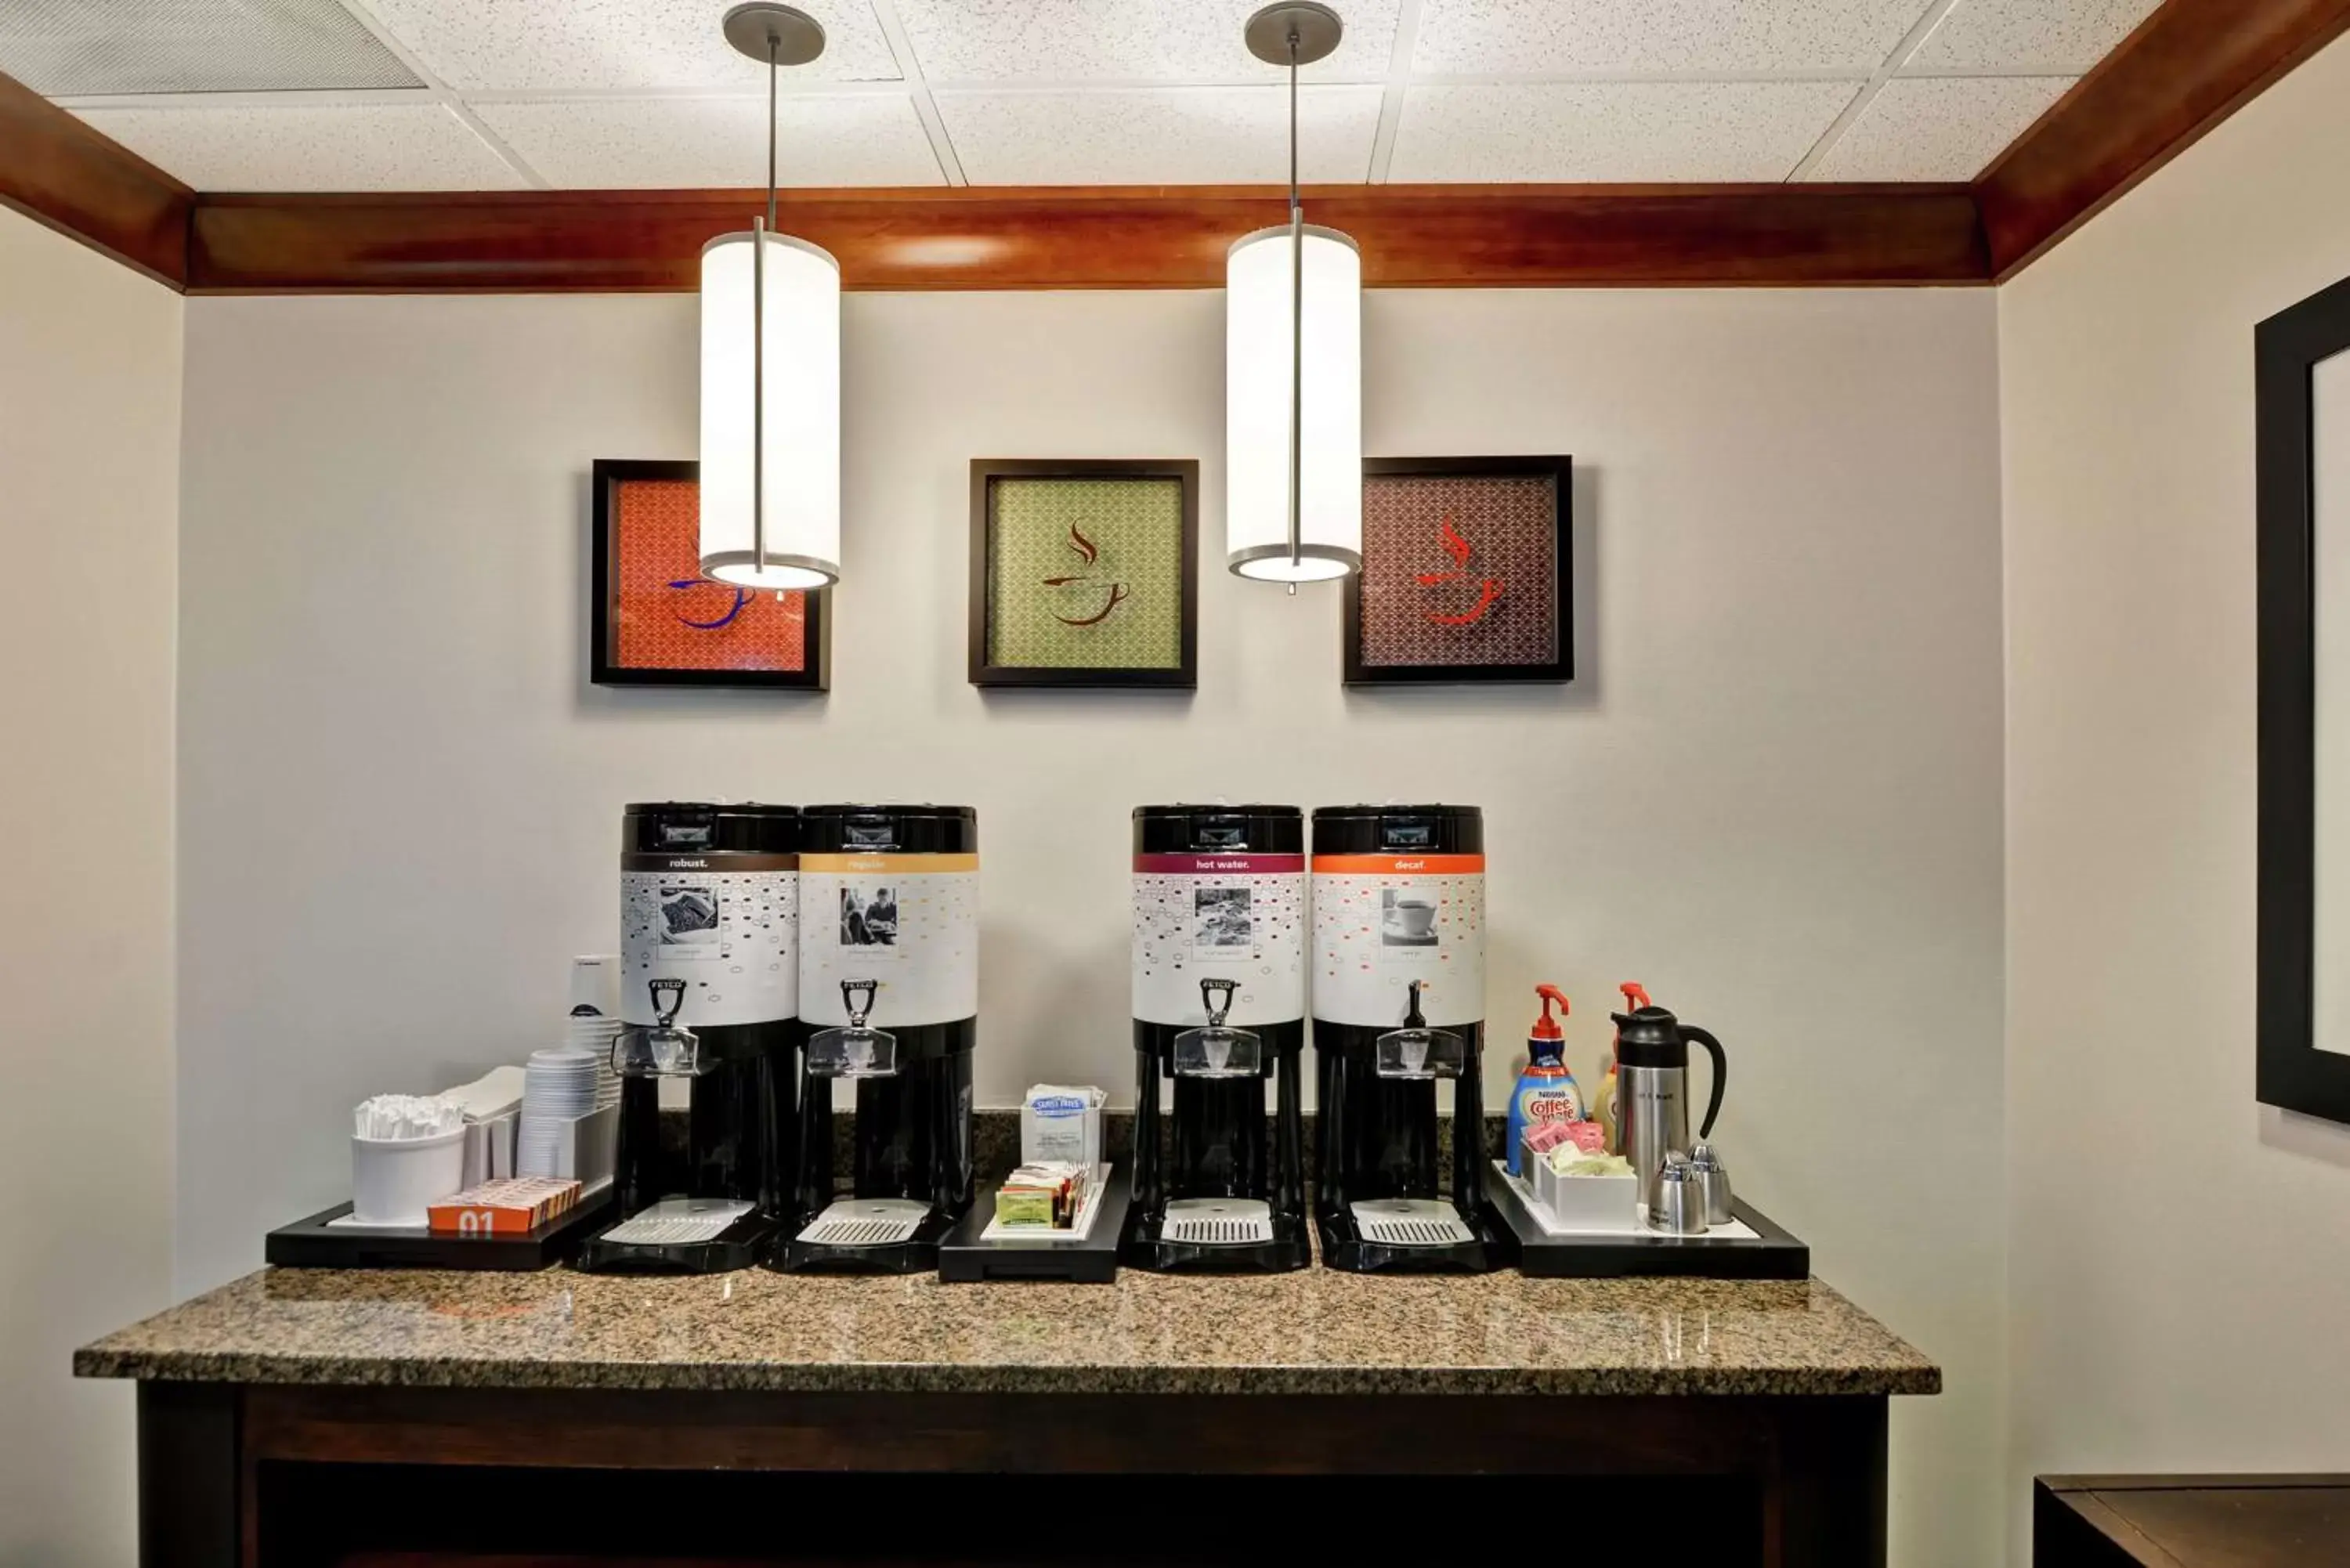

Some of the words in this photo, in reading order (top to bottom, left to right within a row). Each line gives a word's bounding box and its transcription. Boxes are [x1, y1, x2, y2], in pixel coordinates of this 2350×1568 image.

[670, 858, 708, 869] robust.
[1196, 859, 1214, 869] hot
[1217, 860, 1250, 869] water.
[1530, 1099, 1571, 1116] Coffee
